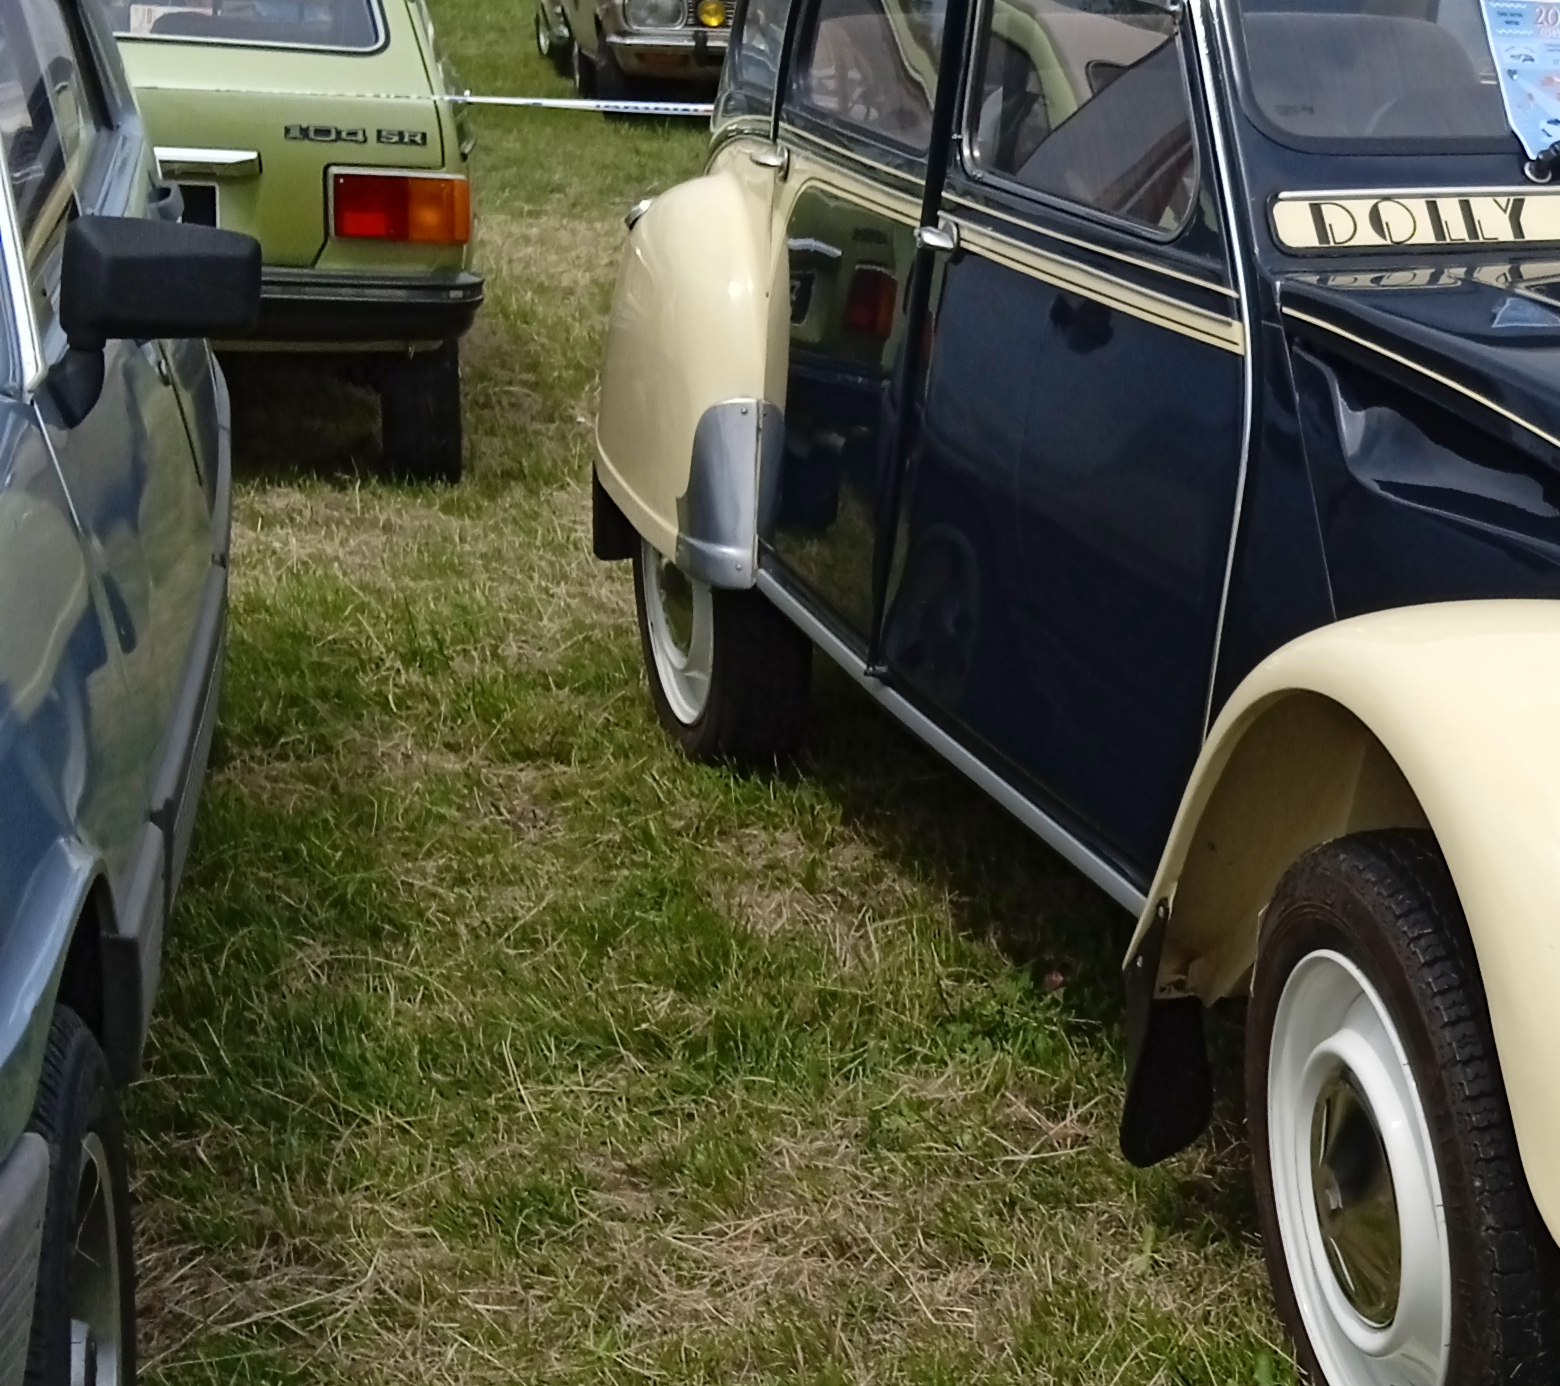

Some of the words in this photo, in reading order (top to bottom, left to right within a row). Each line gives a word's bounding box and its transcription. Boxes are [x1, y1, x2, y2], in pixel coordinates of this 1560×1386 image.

[284, 124, 368, 144] 104
[377, 129, 427, 145] SR
[1309, 197, 1525, 245] DOLLY
